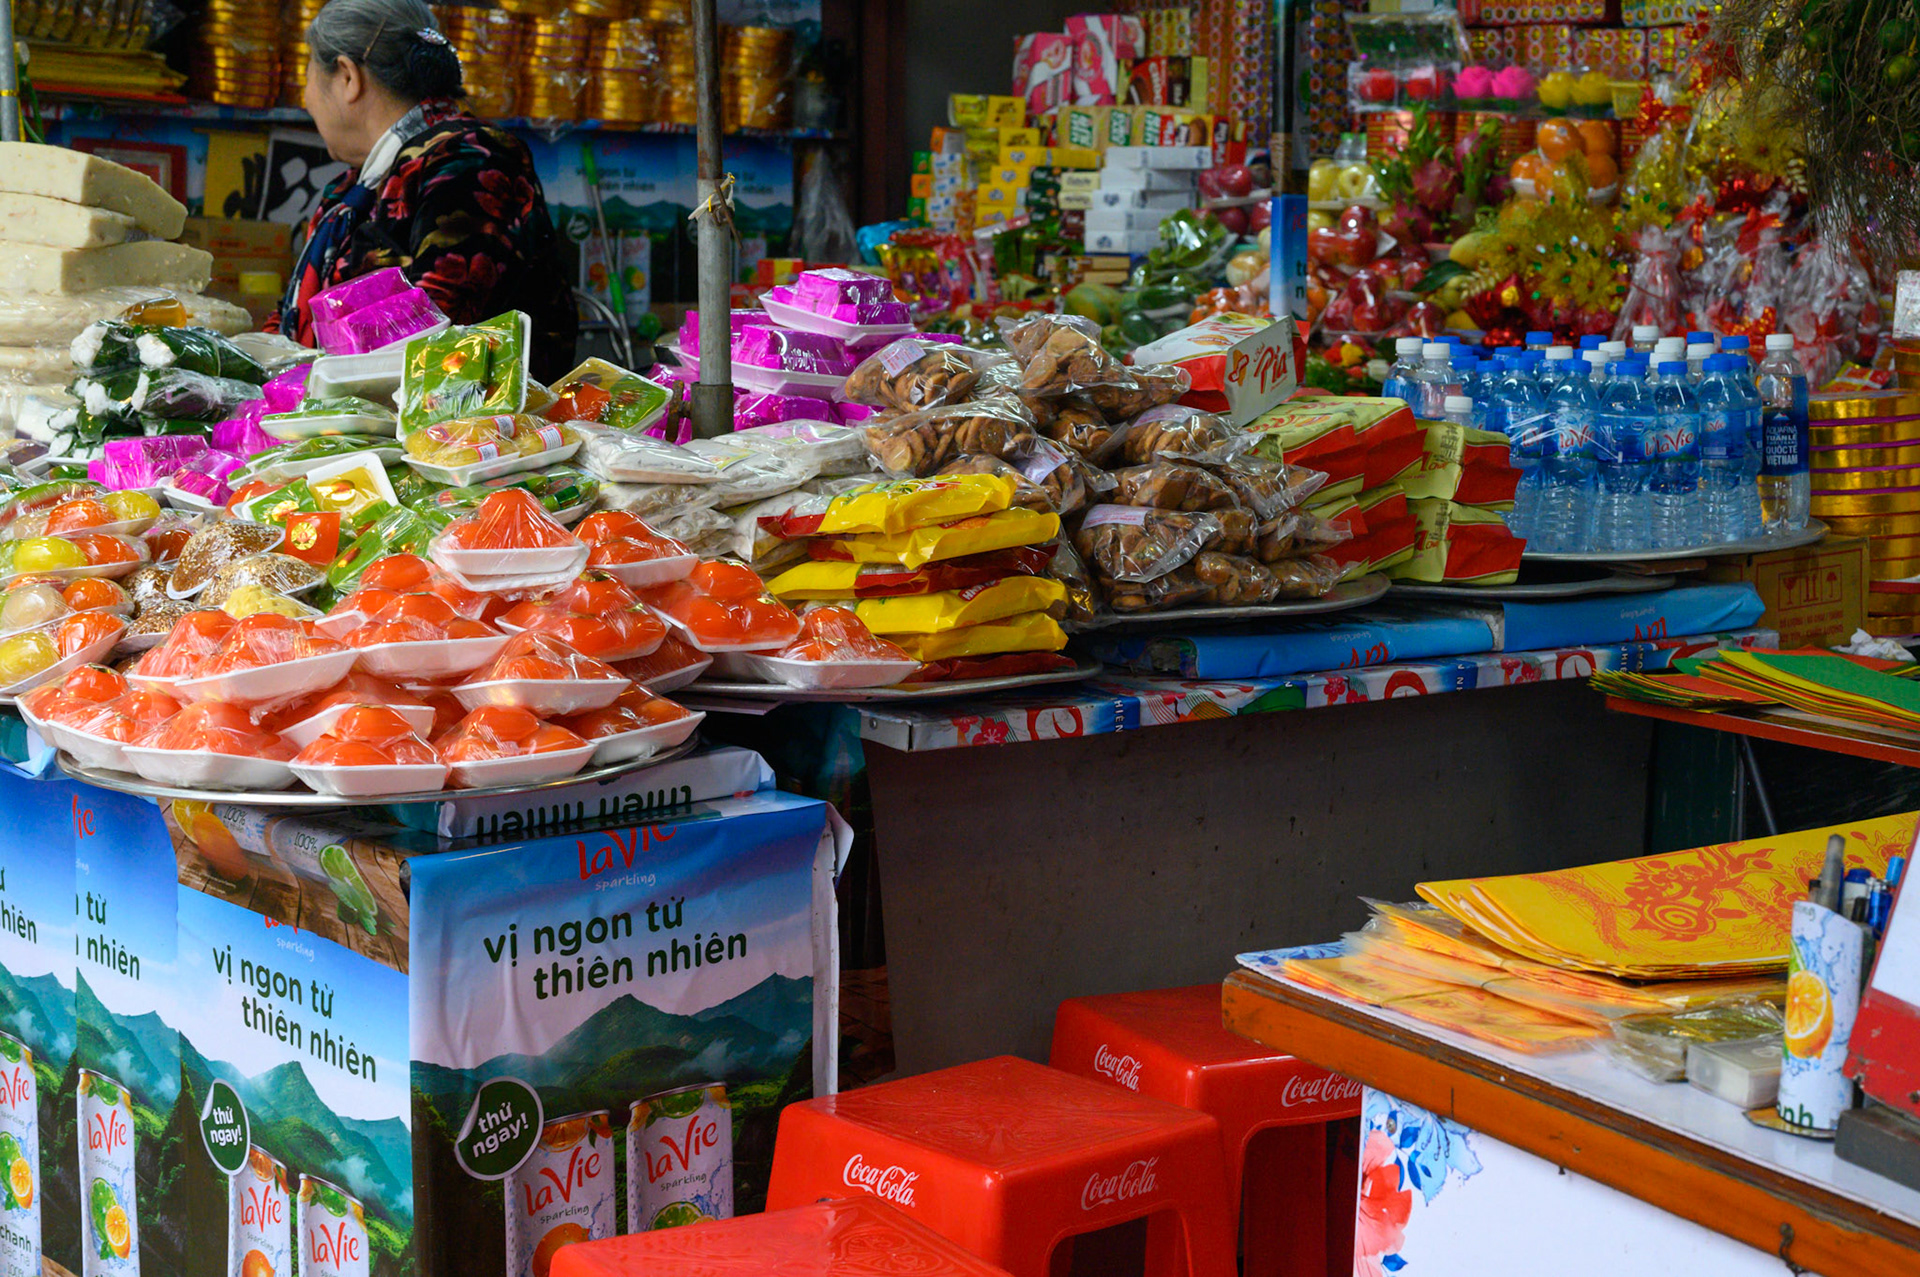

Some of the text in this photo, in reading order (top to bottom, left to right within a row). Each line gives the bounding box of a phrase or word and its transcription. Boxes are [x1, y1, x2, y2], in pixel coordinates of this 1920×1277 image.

[1254, 345, 1288, 395] Pia
[1655, 428, 1695, 455] laVie
[594, 872, 656, 892] sparkling
[0, 902, 37, 944] hiên
[483, 896, 685, 968] vị ngon từ
[87, 934, 140, 981] nhiên
[212, 944, 335, 1019] vị ngon từ
[533, 932, 747, 1000] thiên nhiên
[242, 996, 377, 1083] thiên nhiên
[1094, 1043, 1141, 1092] Coca-Cola
[87, 1109, 128, 1156] laVie
[210, 1124, 243, 1147] ngay!
[212, 1106, 234, 1125] thử
[472, 1113, 530, 1158] ngay!
[477, 1101, 513, 1134] thử
[645, 1115, 719, 1184] laVie
[523, 1146, 602, 1217] laVie
[660, 1172, 708, 1192] sparkling
[842, 1153, 922, 1208] Coca-Cola
[1081, 1156, 1160, 1211] Coca-Cola
[239, 1185, 283, 1233] laVie
[539, 1204, 590, 1225] sparkling
[310, 1221, 360, 1272] laVie
